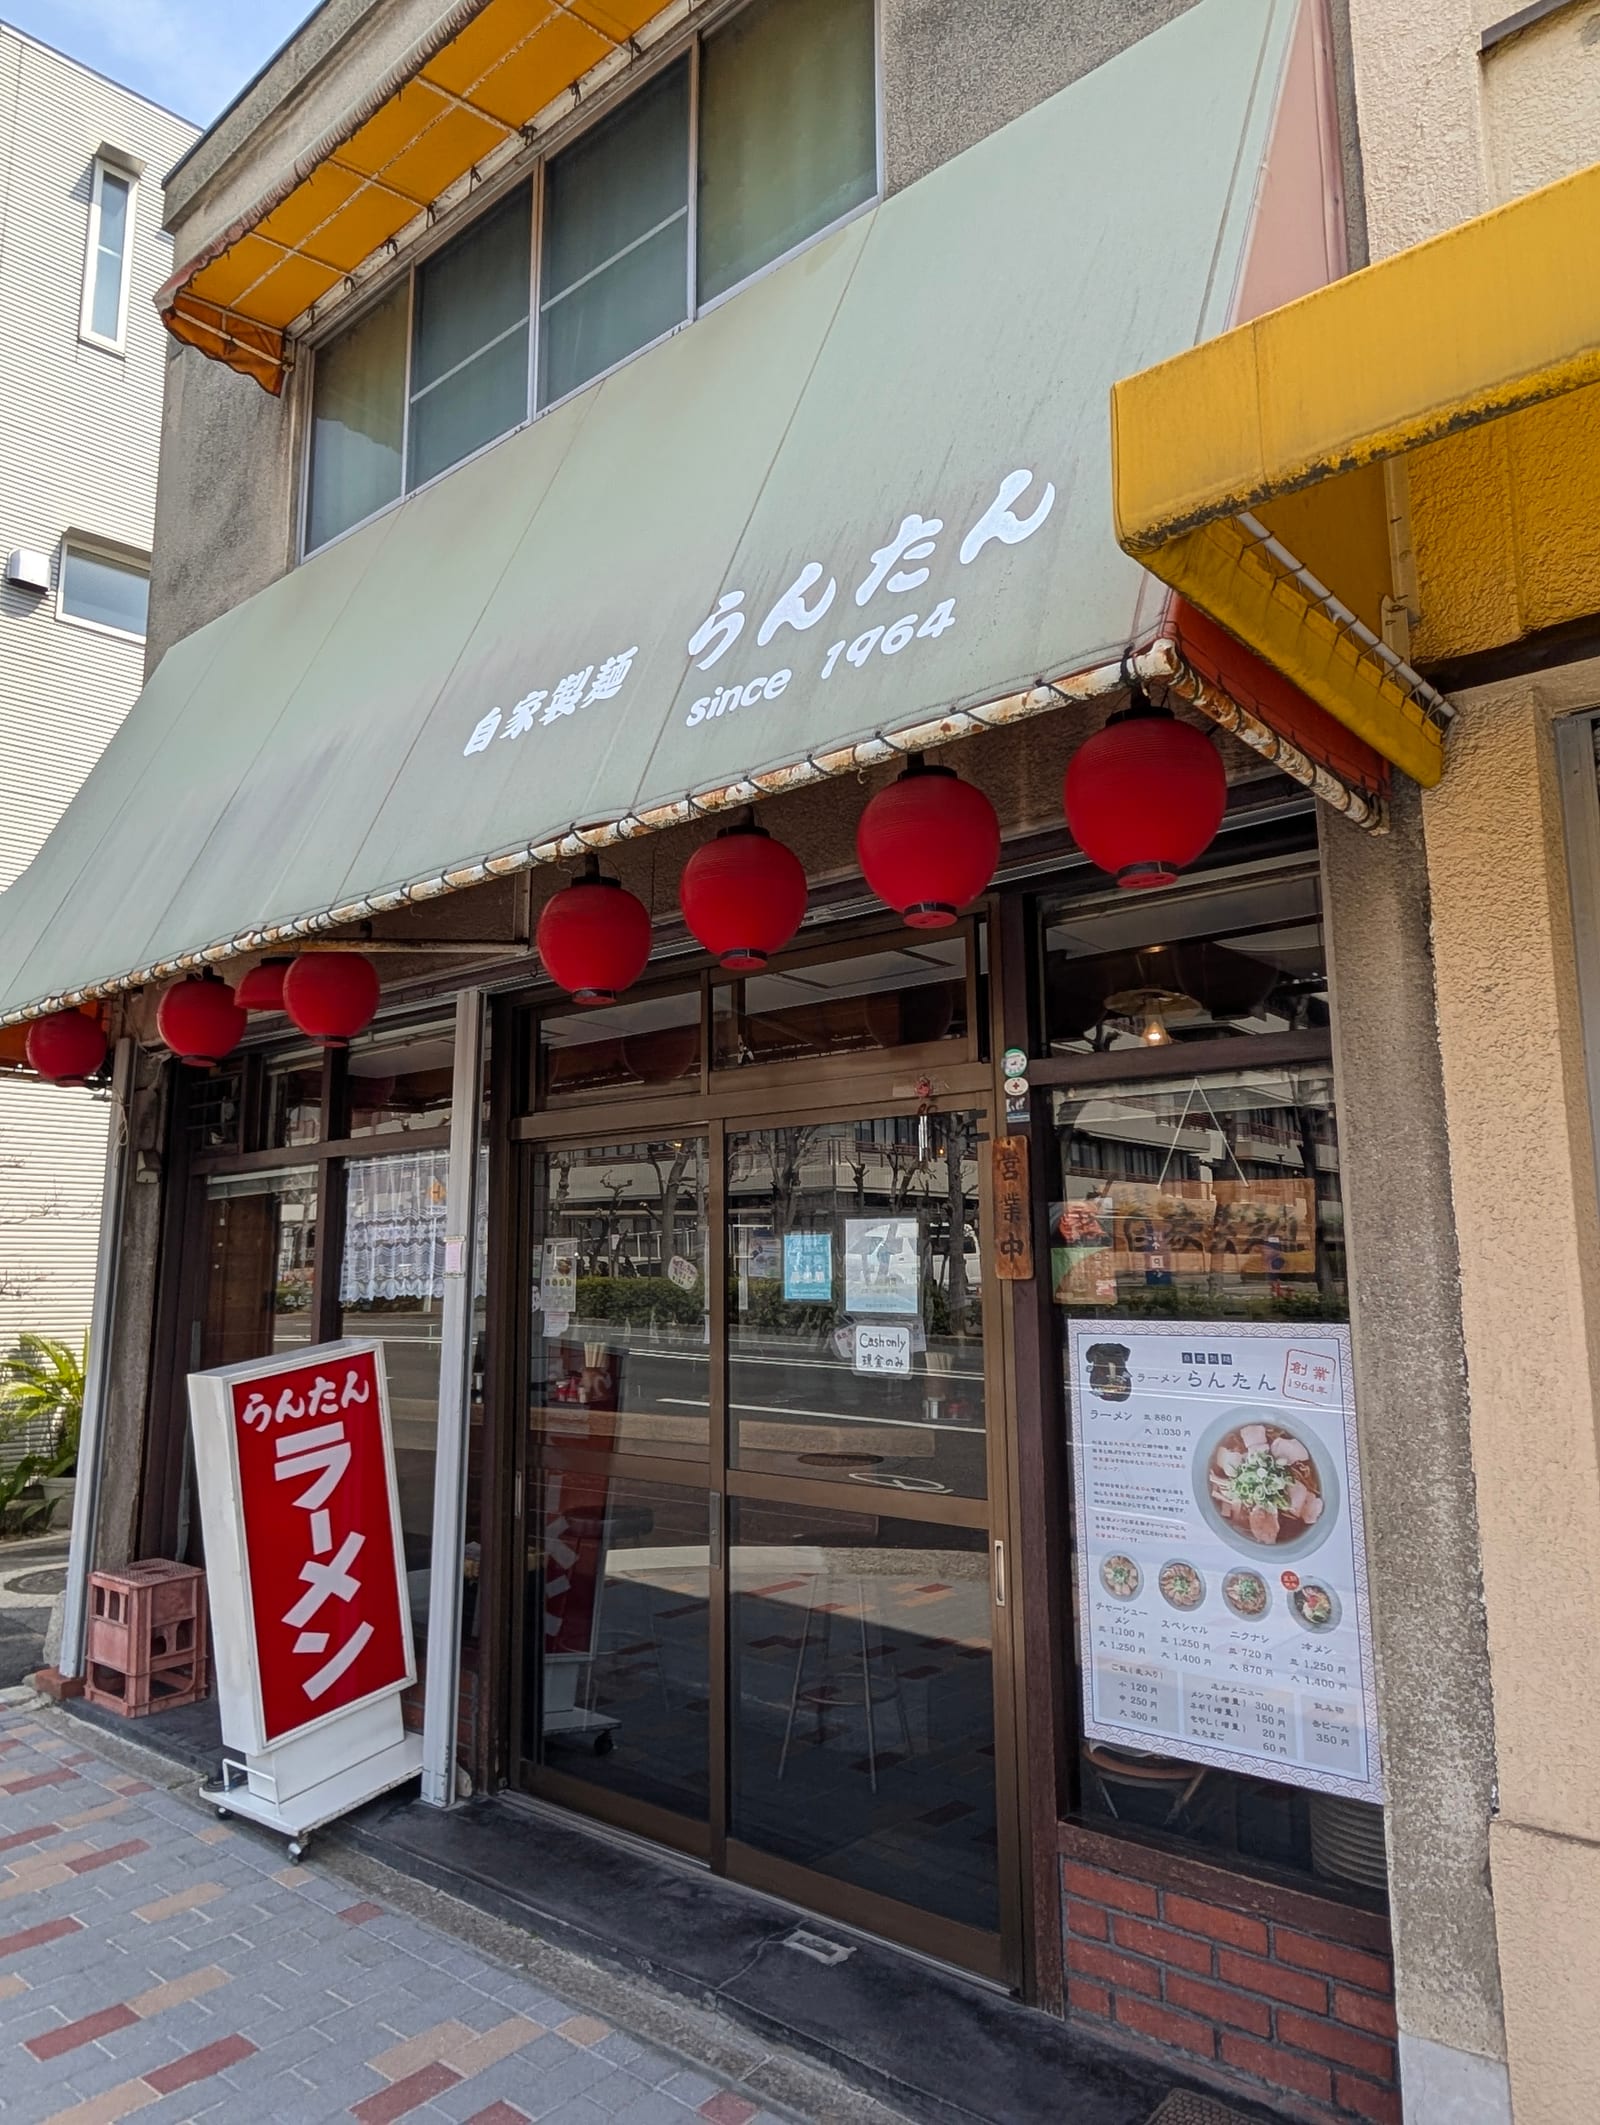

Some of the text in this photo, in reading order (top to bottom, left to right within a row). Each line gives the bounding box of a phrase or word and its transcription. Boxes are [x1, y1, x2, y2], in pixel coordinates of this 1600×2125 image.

[688, 469, 1055, 671] らんたん
[687, 598, 956, 727] since 1964
[463, 646, 639, 757] 自家製麺
[999, 1151, 1025, 1264] 営業中
[859, 1332, 886, 1349] Cash
[886, 1333, 906, 1353] only
[861, 1353, 905, 1368] 現金のみ
[1289, 1361, 1330, 1382] 創業
[1137, 1370, 1276, 1391] ラーメン らんたん
[1288, 1378, 1328, 1394] 1964年
[243, 1371, 369, 1432] らんたん
[1090, 1410, 1133, 1420] ラーメン
[274, 1421, 375, 1701] ラーメン
[1096, 1602, 1148, 1617] チャーシュー
[1161, 1620, 1208, 1635] スペシャル
[1230, 1631, 1269, 1643] ニクナシ
[1241, 1648, 1261, 1659] 720
[1242, 1664, 1262, 1676] 870
[1130, 1682, 1148, 1693] 120
[1130, 1696, 1148, 1707] 250
[1255, 1701, 1274, 1713] 300
[1130, 1710, 1148, 1722] 300
[1255, 1713, 1274, 1725] 150
[1262, 1728, 1275, 1739] 20
[1316, 1733, 1337, 1745] 350
[1263, 1742, 1276, 1752] 60
